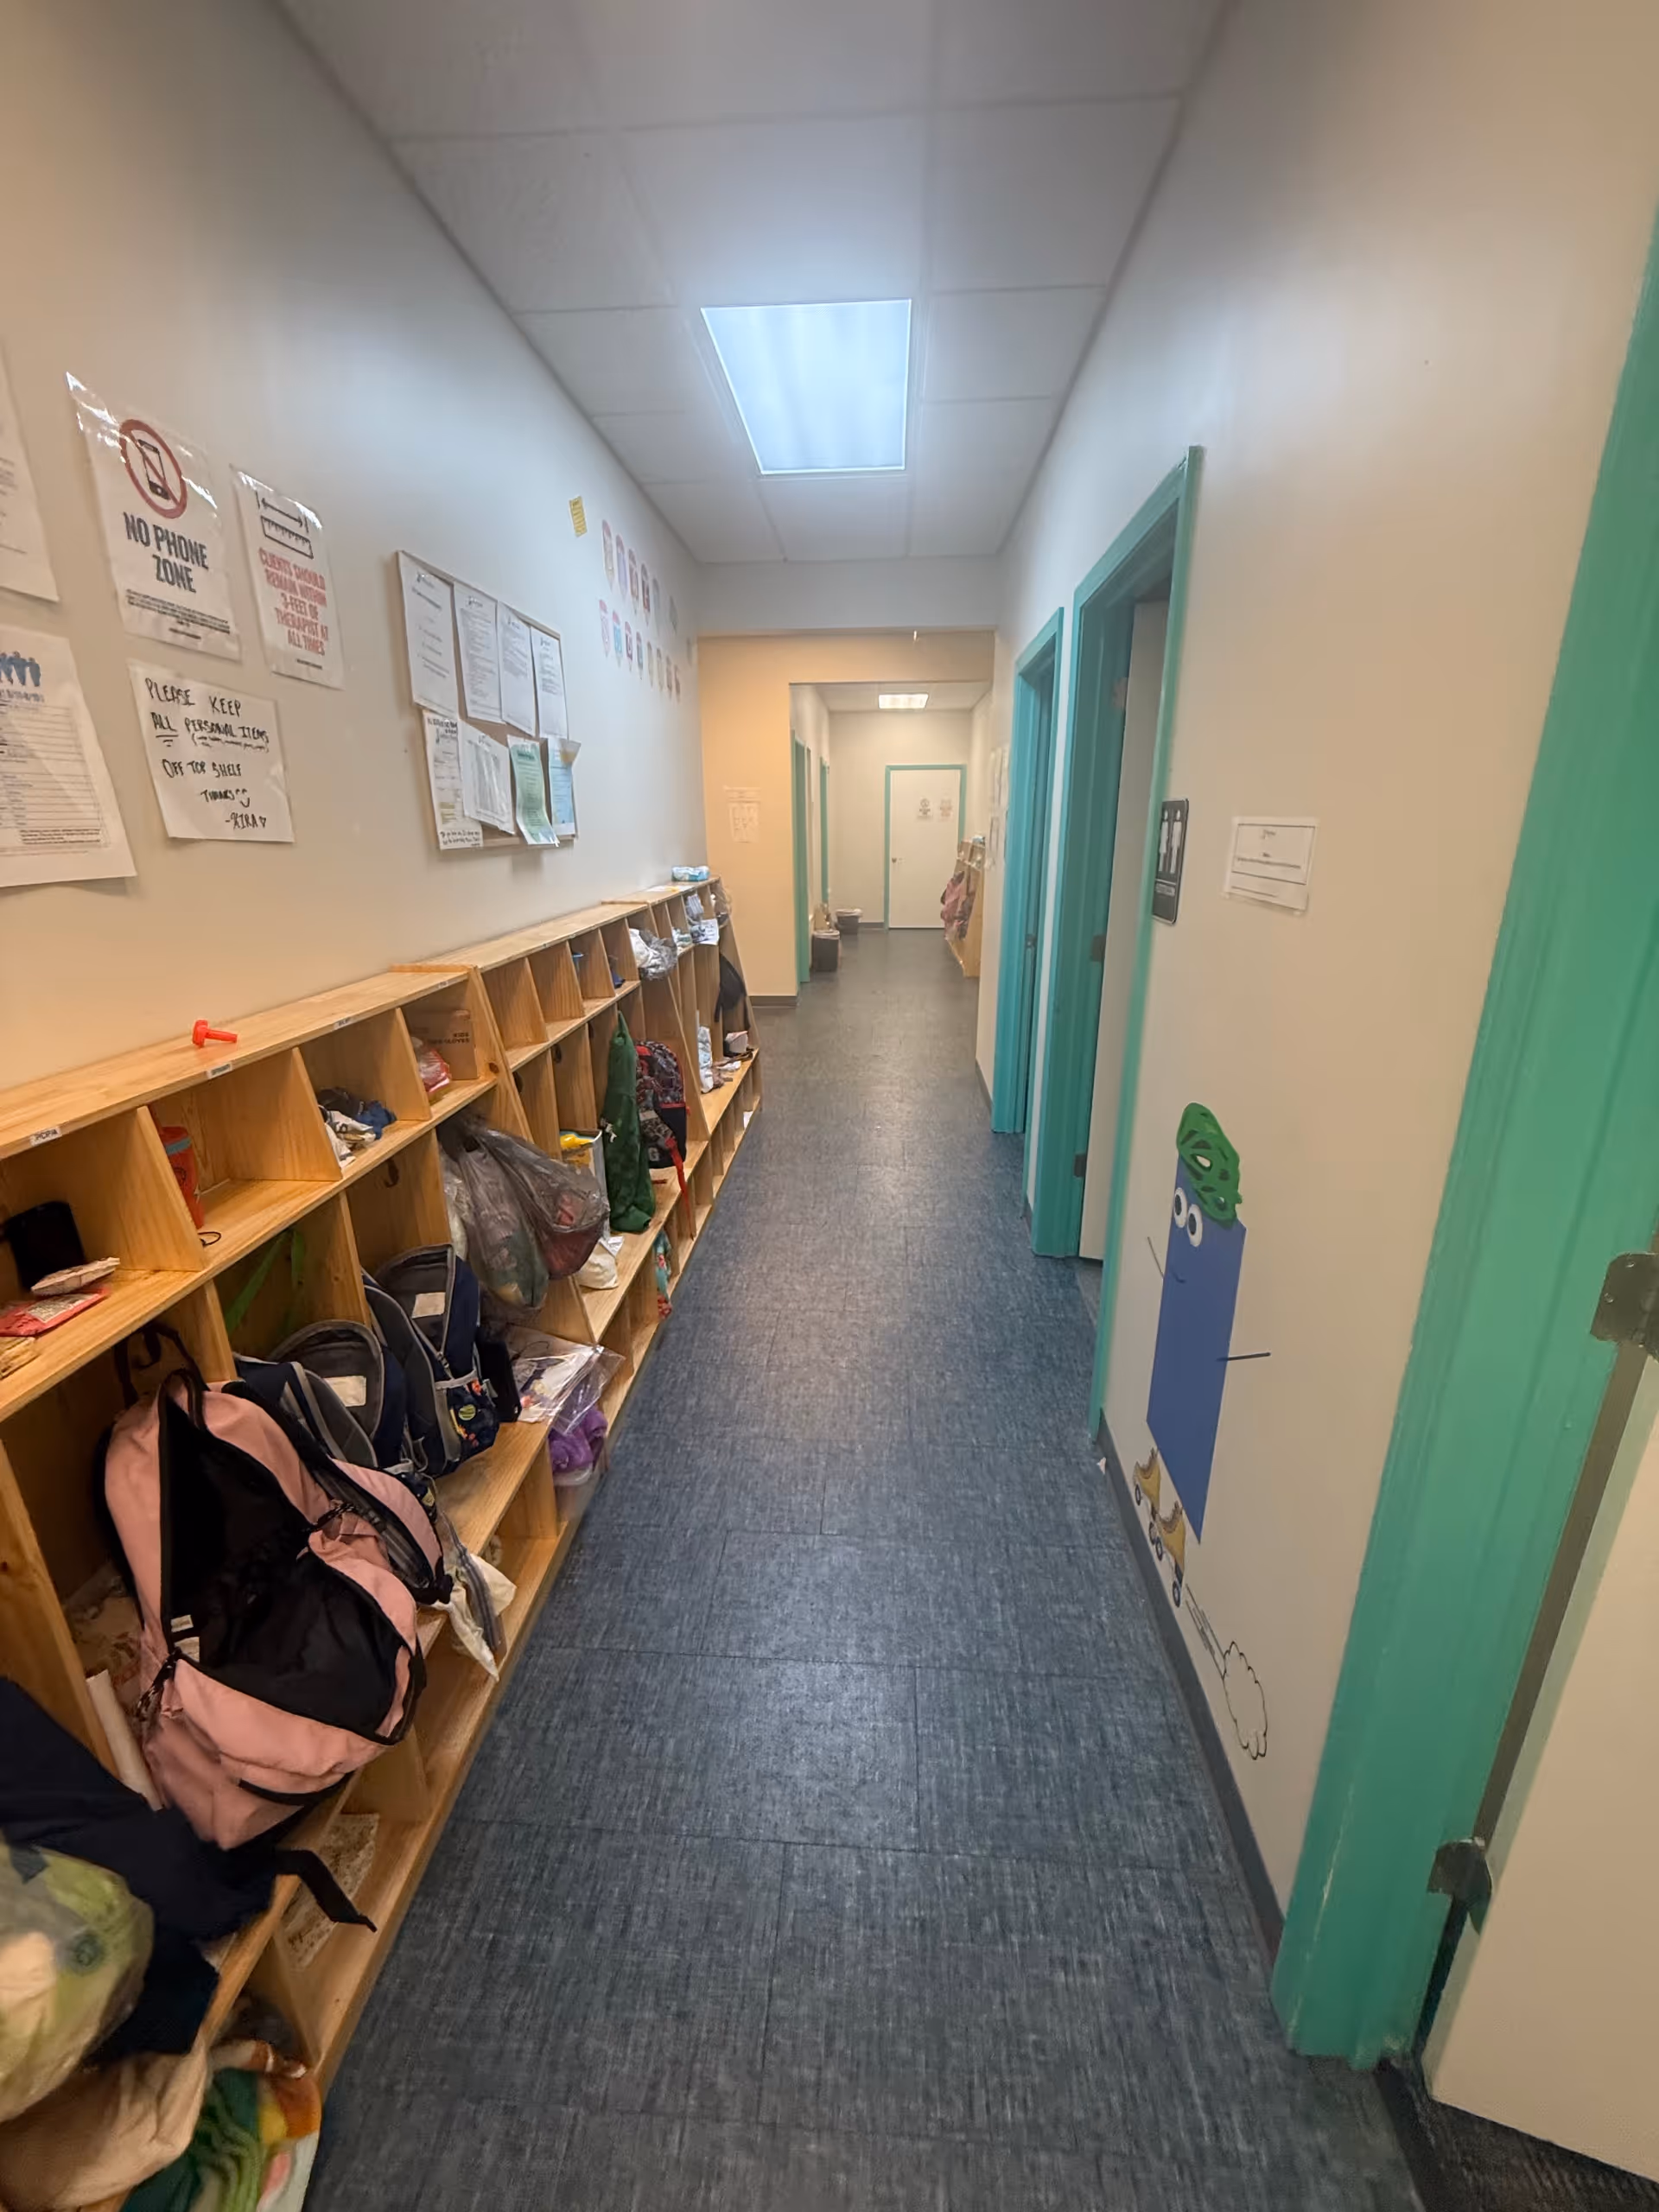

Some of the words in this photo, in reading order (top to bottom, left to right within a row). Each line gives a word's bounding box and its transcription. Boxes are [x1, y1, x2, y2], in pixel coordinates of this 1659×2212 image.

[124, 512, 150, 547] NO
[152, 524, 209, 570] PHONE
[152, 554, 197, 594] ZONE
[275, 607, 319, 639] THERAPIST
[288, 629, 302, 648] ALL
[302, 633, 326, 657] TIMES
[145, 677, 195, 706] PLEASE
[208, 696, 242, 717] KEEP
[150, 712, 178, 732] ALL
[184, 717, 237, 738] PERSONAL
[238, 726, 270, 744] ITEMS
[162, 759, 184, 778] OFF
[187, 760, 207, 774] TOP
[212, 762, 242, 778] SHELF
[200, 789, 236, 803] THANKS
